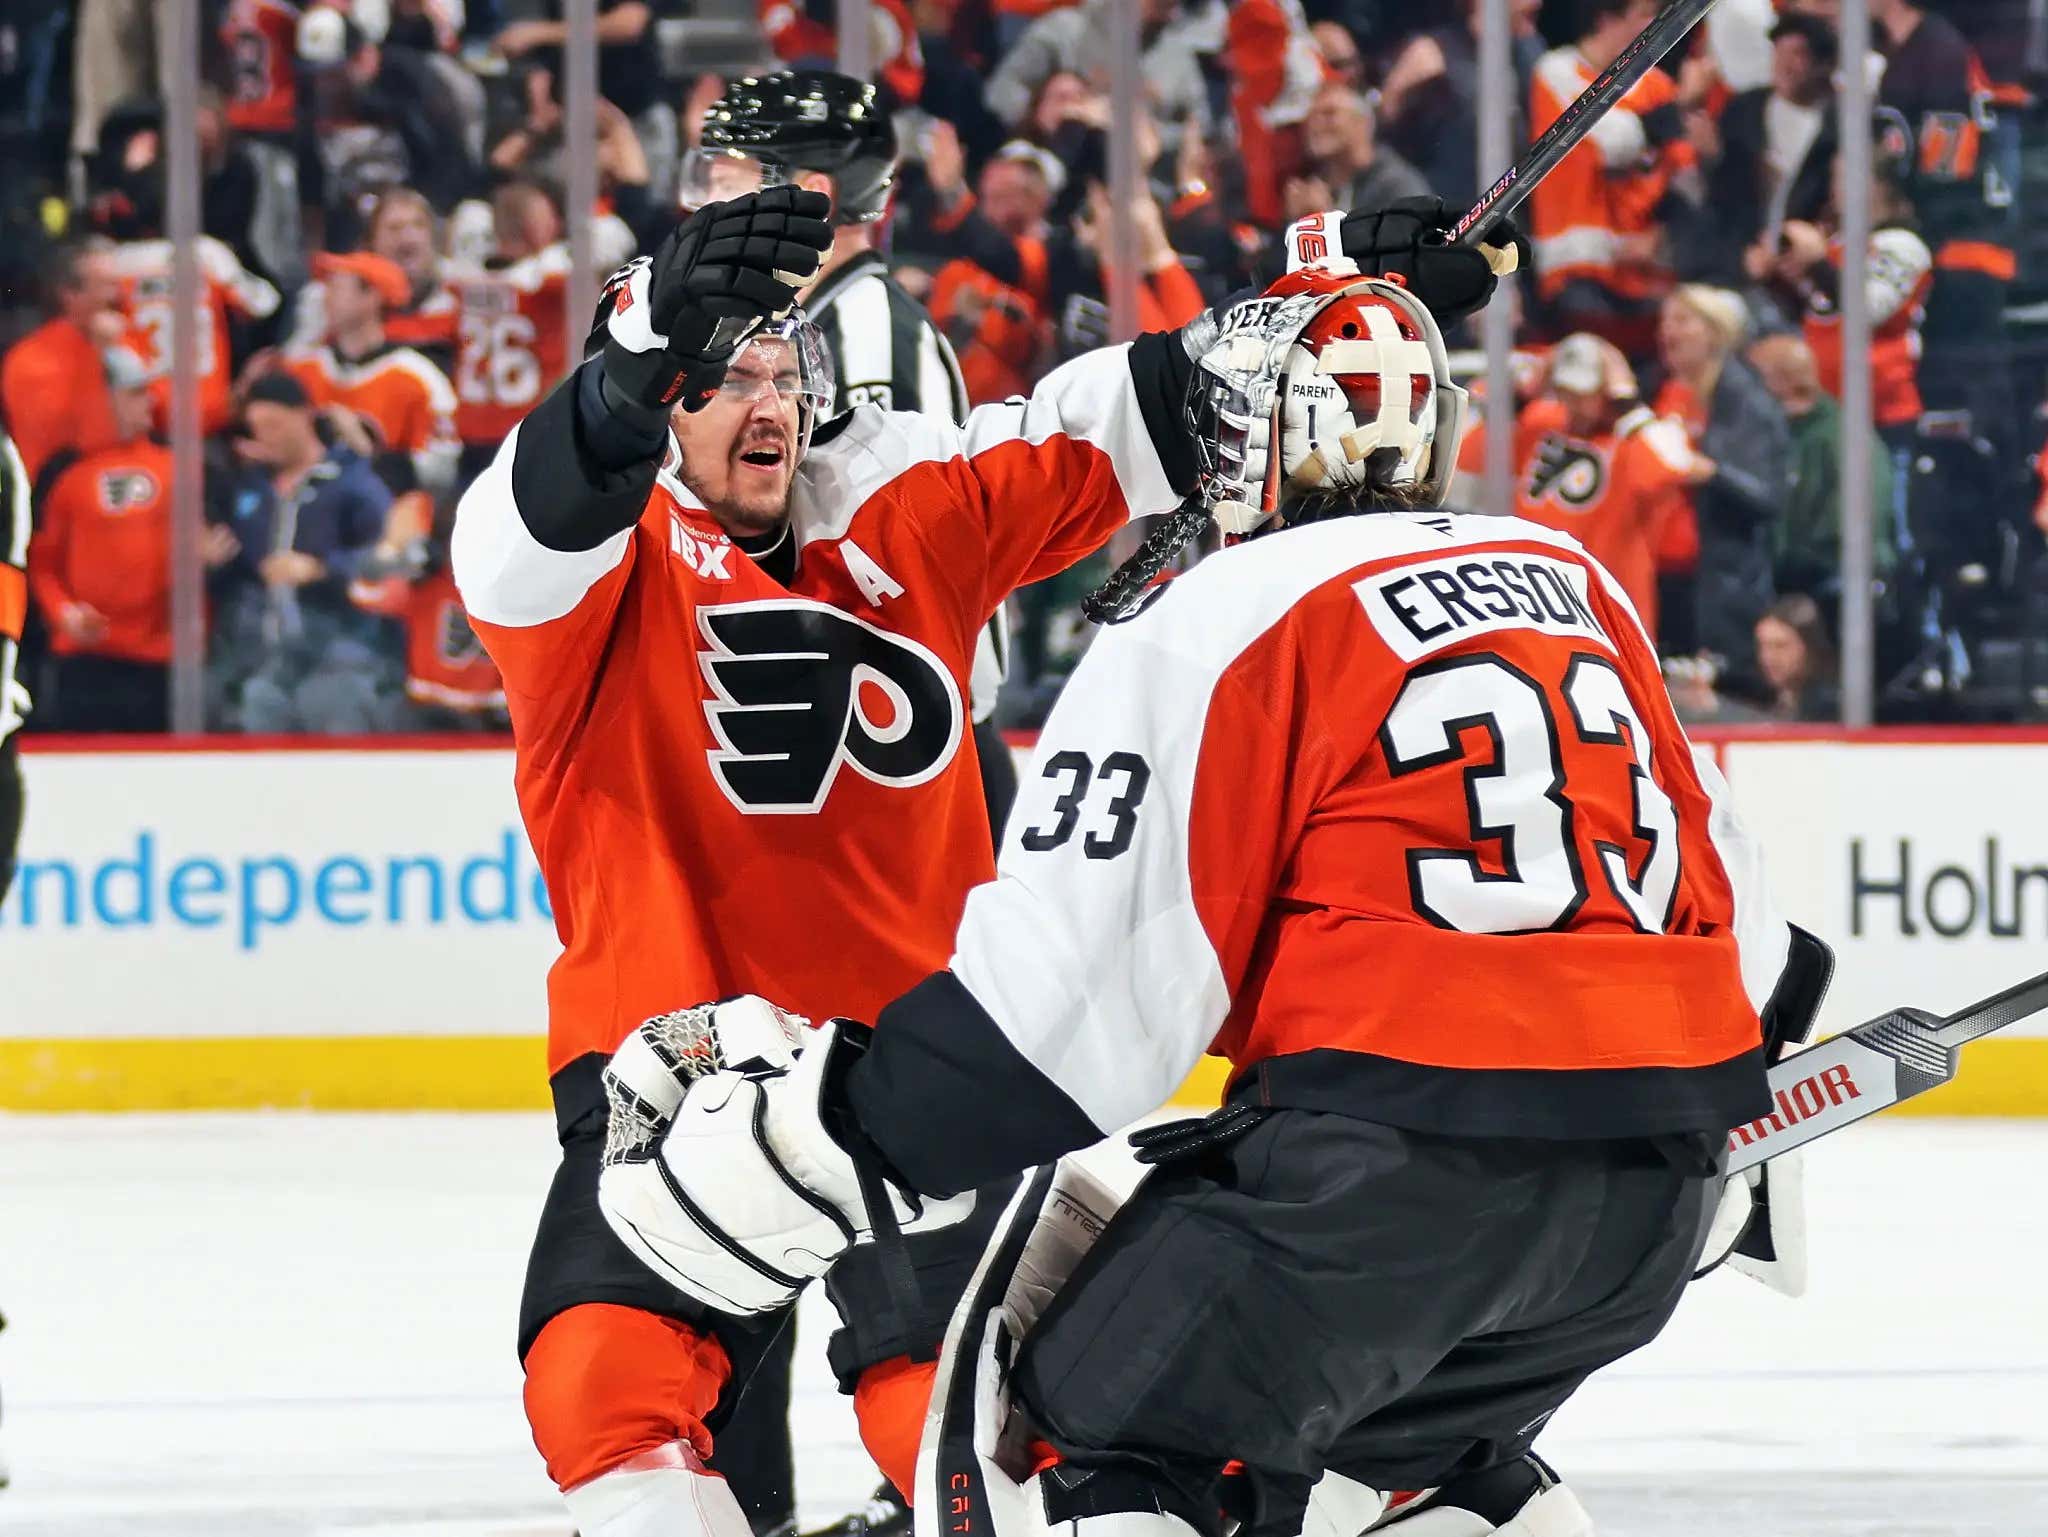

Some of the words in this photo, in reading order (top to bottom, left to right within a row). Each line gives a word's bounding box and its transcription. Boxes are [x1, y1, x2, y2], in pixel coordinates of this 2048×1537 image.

[458, 312, 542, 406] 26
[1292, 384, 1337, 400] PARENT
[671, 516, 733, 580] IBX
[838, 538, 906, 608] A
[1379, 560, 1605, 644] ERSSON
[1020, 749, 1153, 861] 33
[1378, 650, 1682, 936] 33
[6, 830, 556, 949] ndepend
